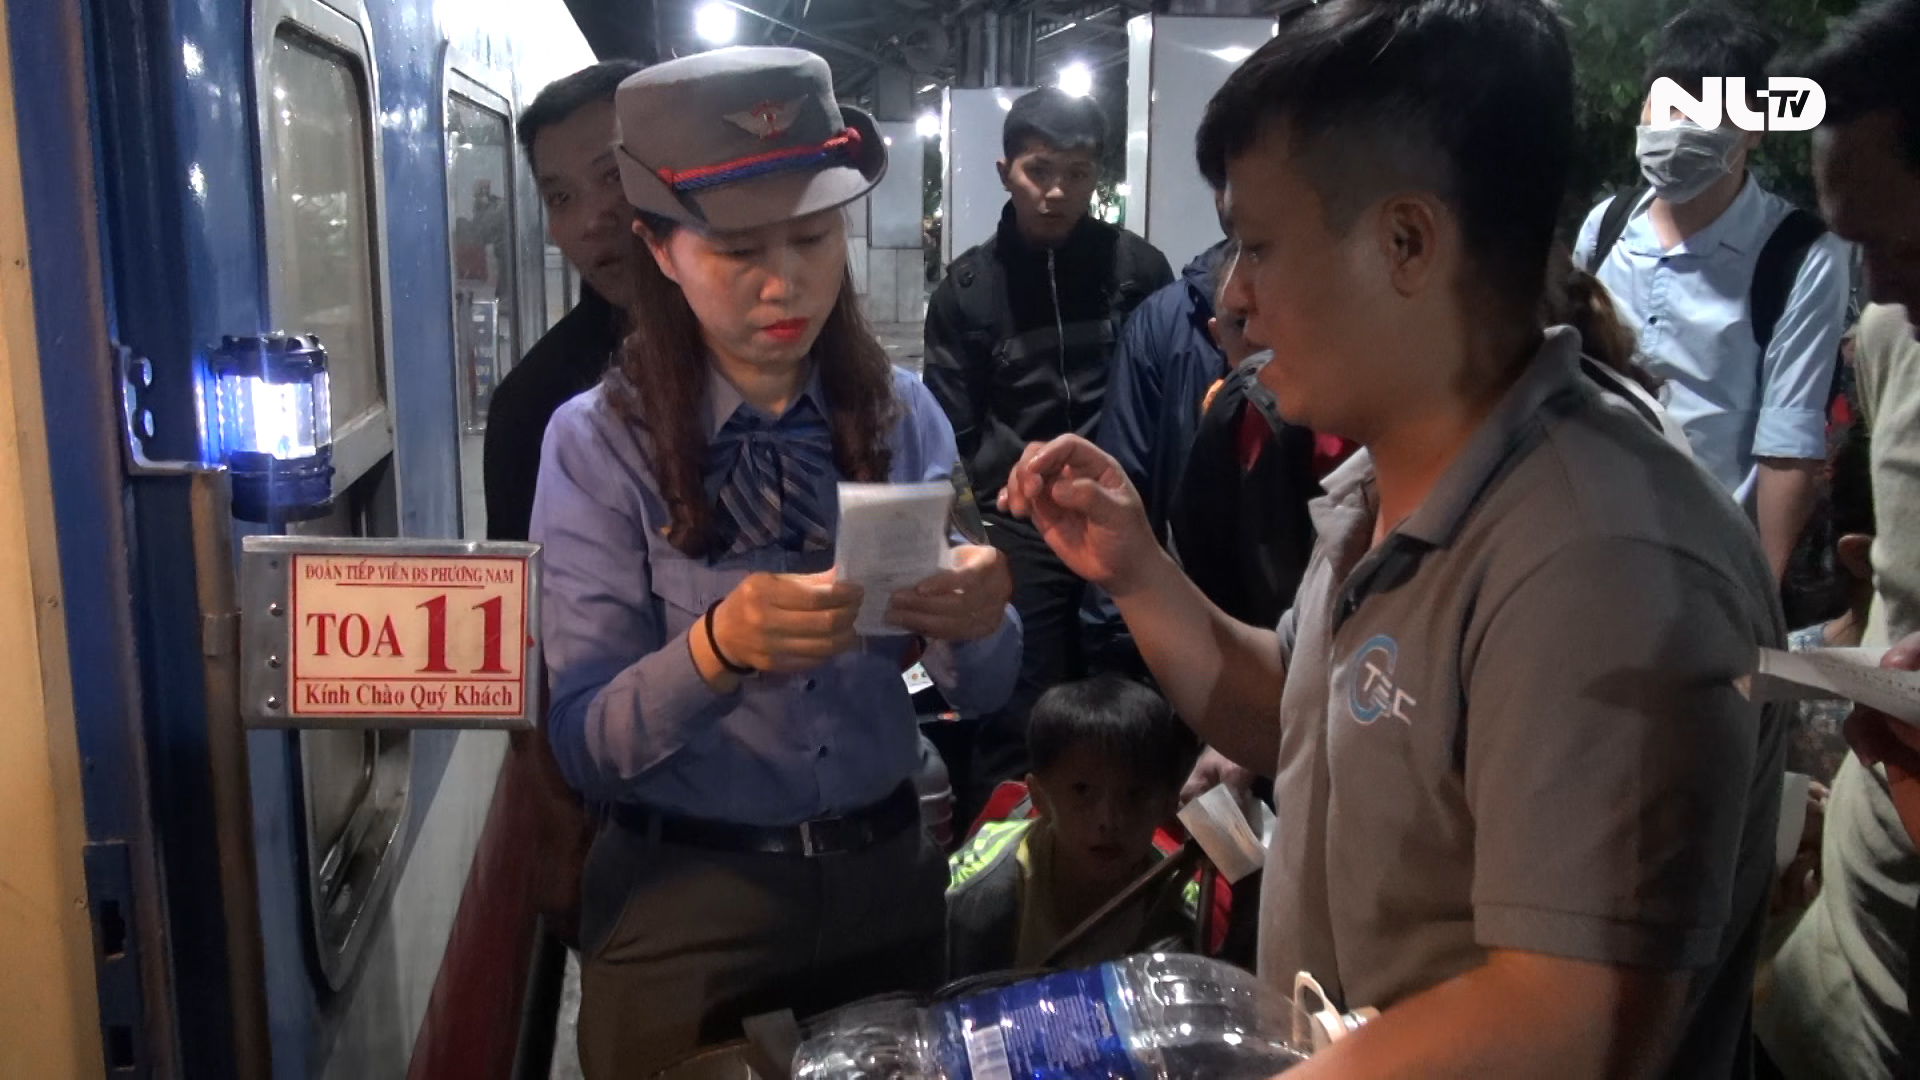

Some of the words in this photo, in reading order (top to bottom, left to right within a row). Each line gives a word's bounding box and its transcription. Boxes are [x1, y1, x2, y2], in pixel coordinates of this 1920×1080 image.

[345, 559, 376, 580] TIẾP
[378, 561, 409, 581] VIÊN
[431, 564, 483, 583] PHƯƠNG
[485, 567, 514, 584] NAM
[306, 613, 404, 658] TOA
[415, 594, 512, 674] 11
[305, 684, 350, 705] Kính
[356, 683, 405, 706] Chào
[410, 684, 448, 711] Quý
[453, 685, 513, 706] Khách
